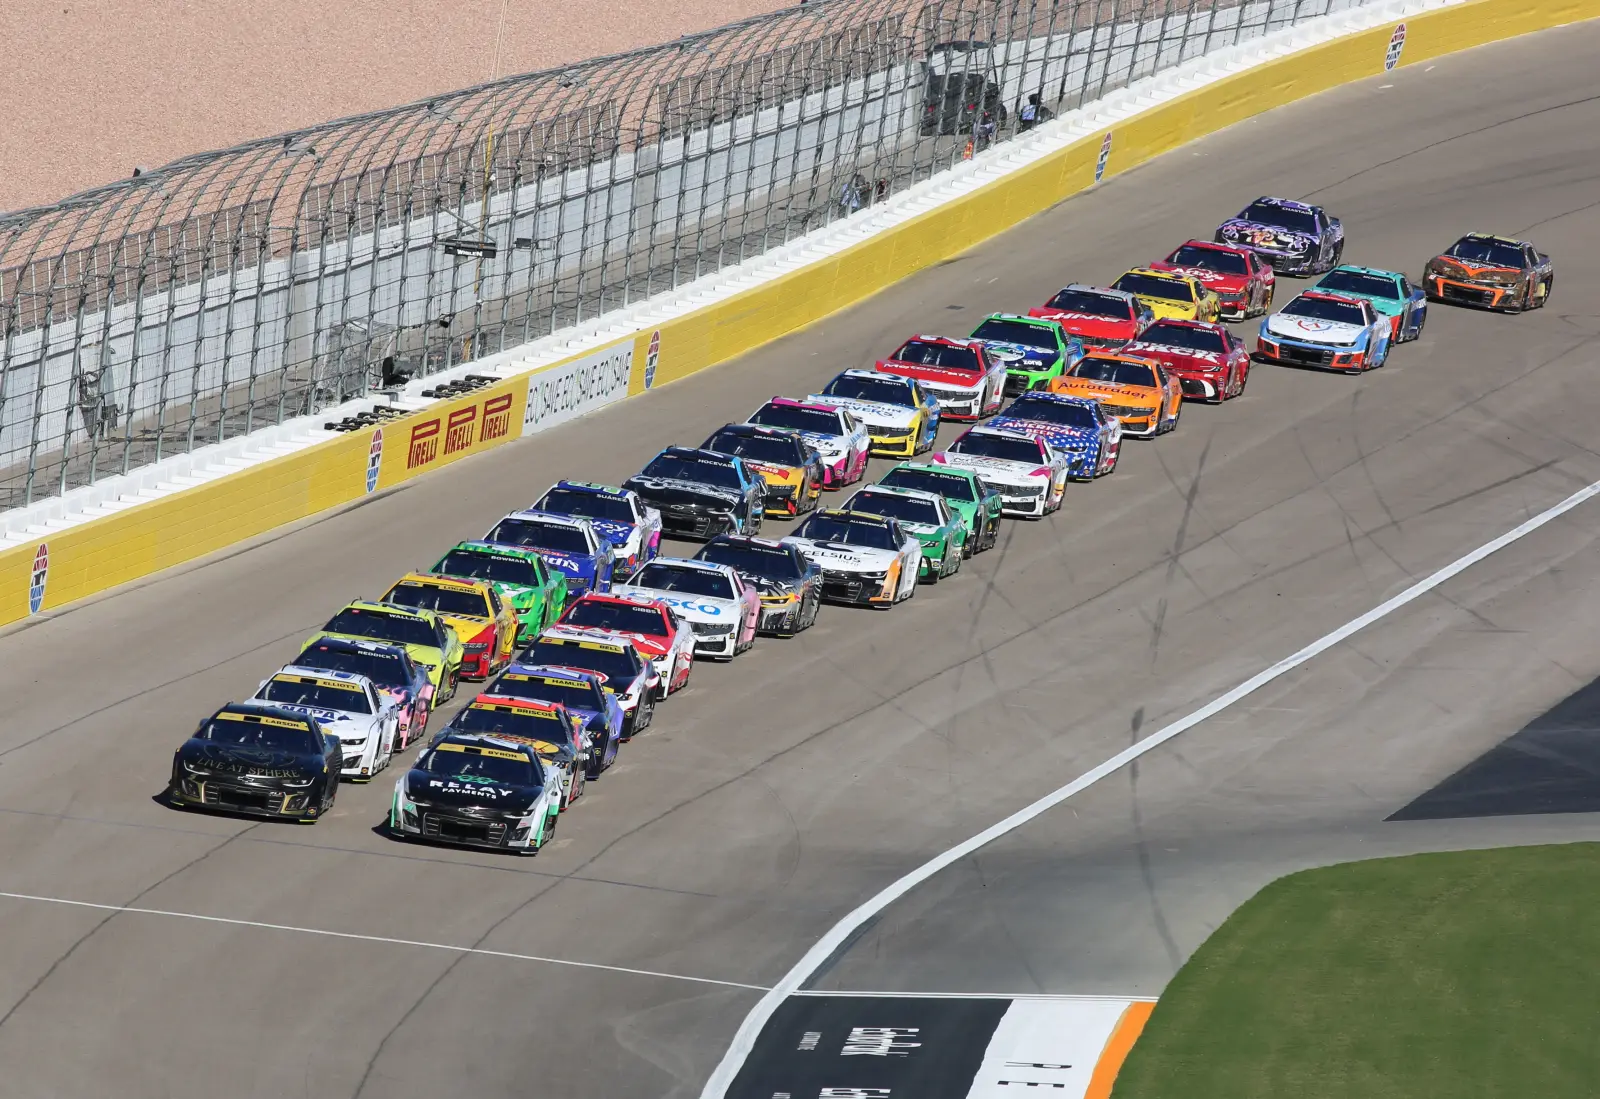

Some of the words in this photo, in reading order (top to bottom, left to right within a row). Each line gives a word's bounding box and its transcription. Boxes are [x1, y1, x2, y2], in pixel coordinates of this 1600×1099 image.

[883, 363, 973, 379] Motorcraft
[1058, 382, 1148, 399] Autotrader
[407, 418, 441, 470] PIRELLI
[443, 405, 478, 456] PIRELLI
[479, 393, 513, 443] PIRELLI
[1002, 421, 1081, 437] AMERICAN
[939, 474, 966, 482] DILLON
[802, 550, 861, 563] CELSIUS
[632, 606, 657, 614] GIBBS
[357, 650, 392, 659] REDDICK
[323, 681, 356, 690] ELLIOTT
[552, 679, 586, 687] HAMLIN
[281, 704, 336, 721] NAPA
[516, 708, 553, 717] BRISCOE
[265, 718, 300, 727] LARSON
[487, 750, 518, 758] BYRON
[197, 758, 225, 770] LIVE
[228, 764, 244, 773] AT
[248, 766, 300, 777] SPHERE
[429, 780, 513, 797] RELAY
[442, 787, 497, 799] PAYMENTS
